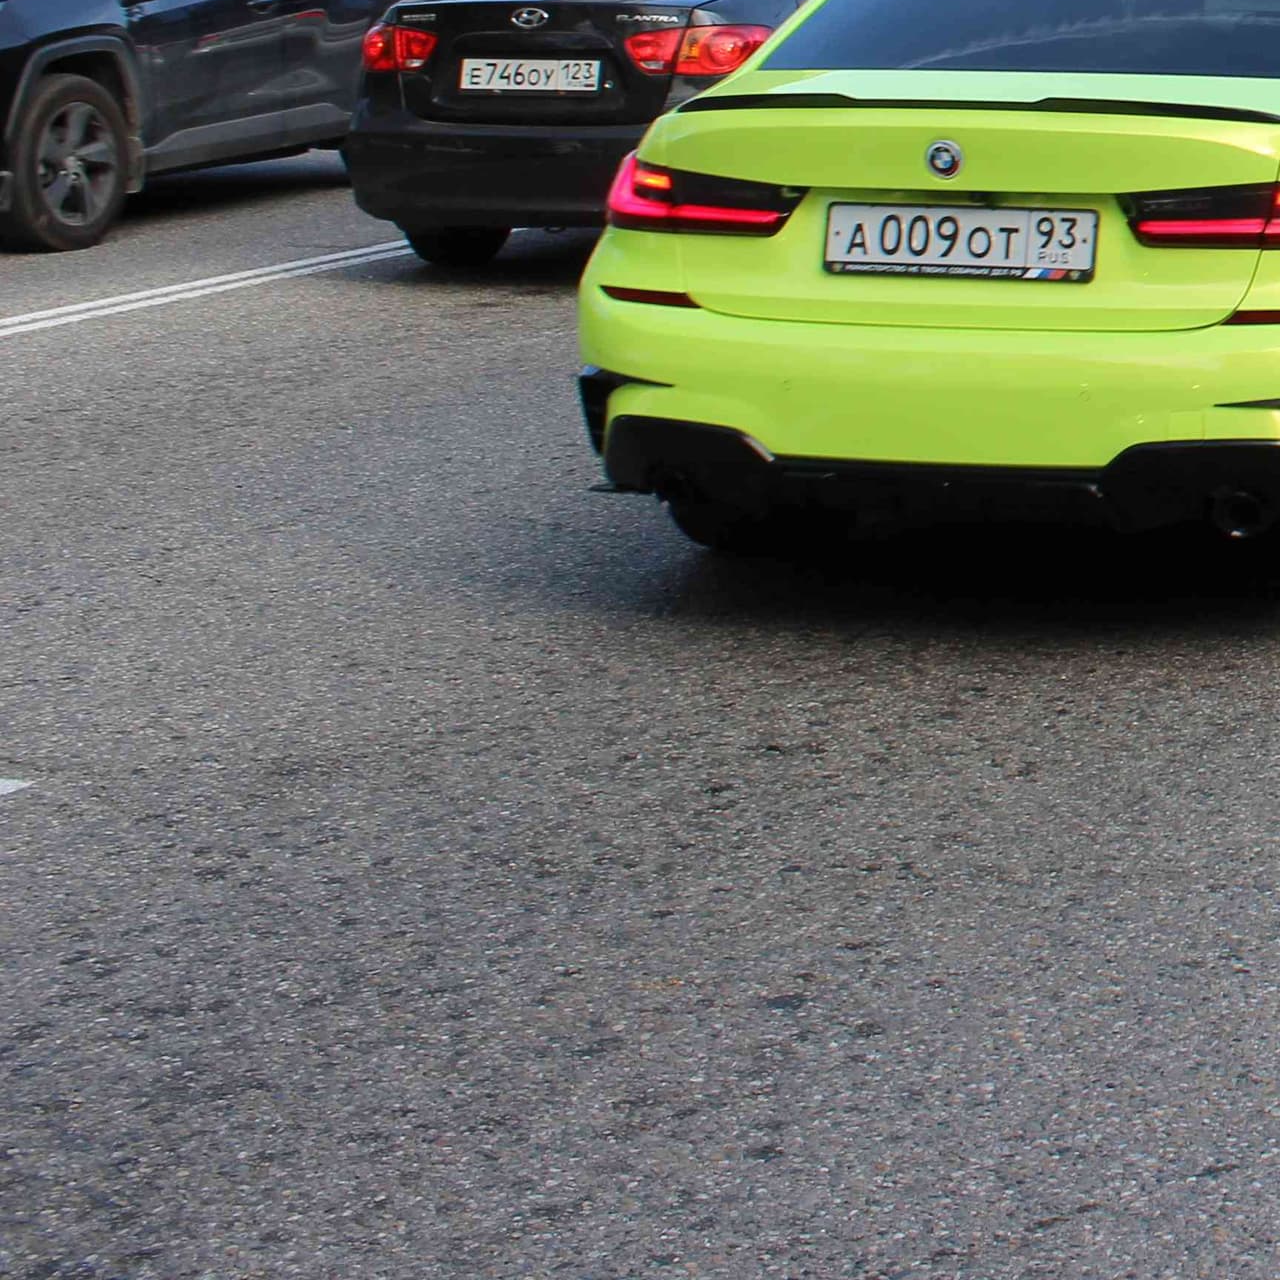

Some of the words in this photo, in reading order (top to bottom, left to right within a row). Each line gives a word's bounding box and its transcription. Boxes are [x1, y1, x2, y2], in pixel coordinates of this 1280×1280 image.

[561, 62, 594, 80] 123
[847, 214, 1020, 260] А009ОТ
[1036, 216, 1077, 250] 93
[1038, 250, 1070, 264] RUS
